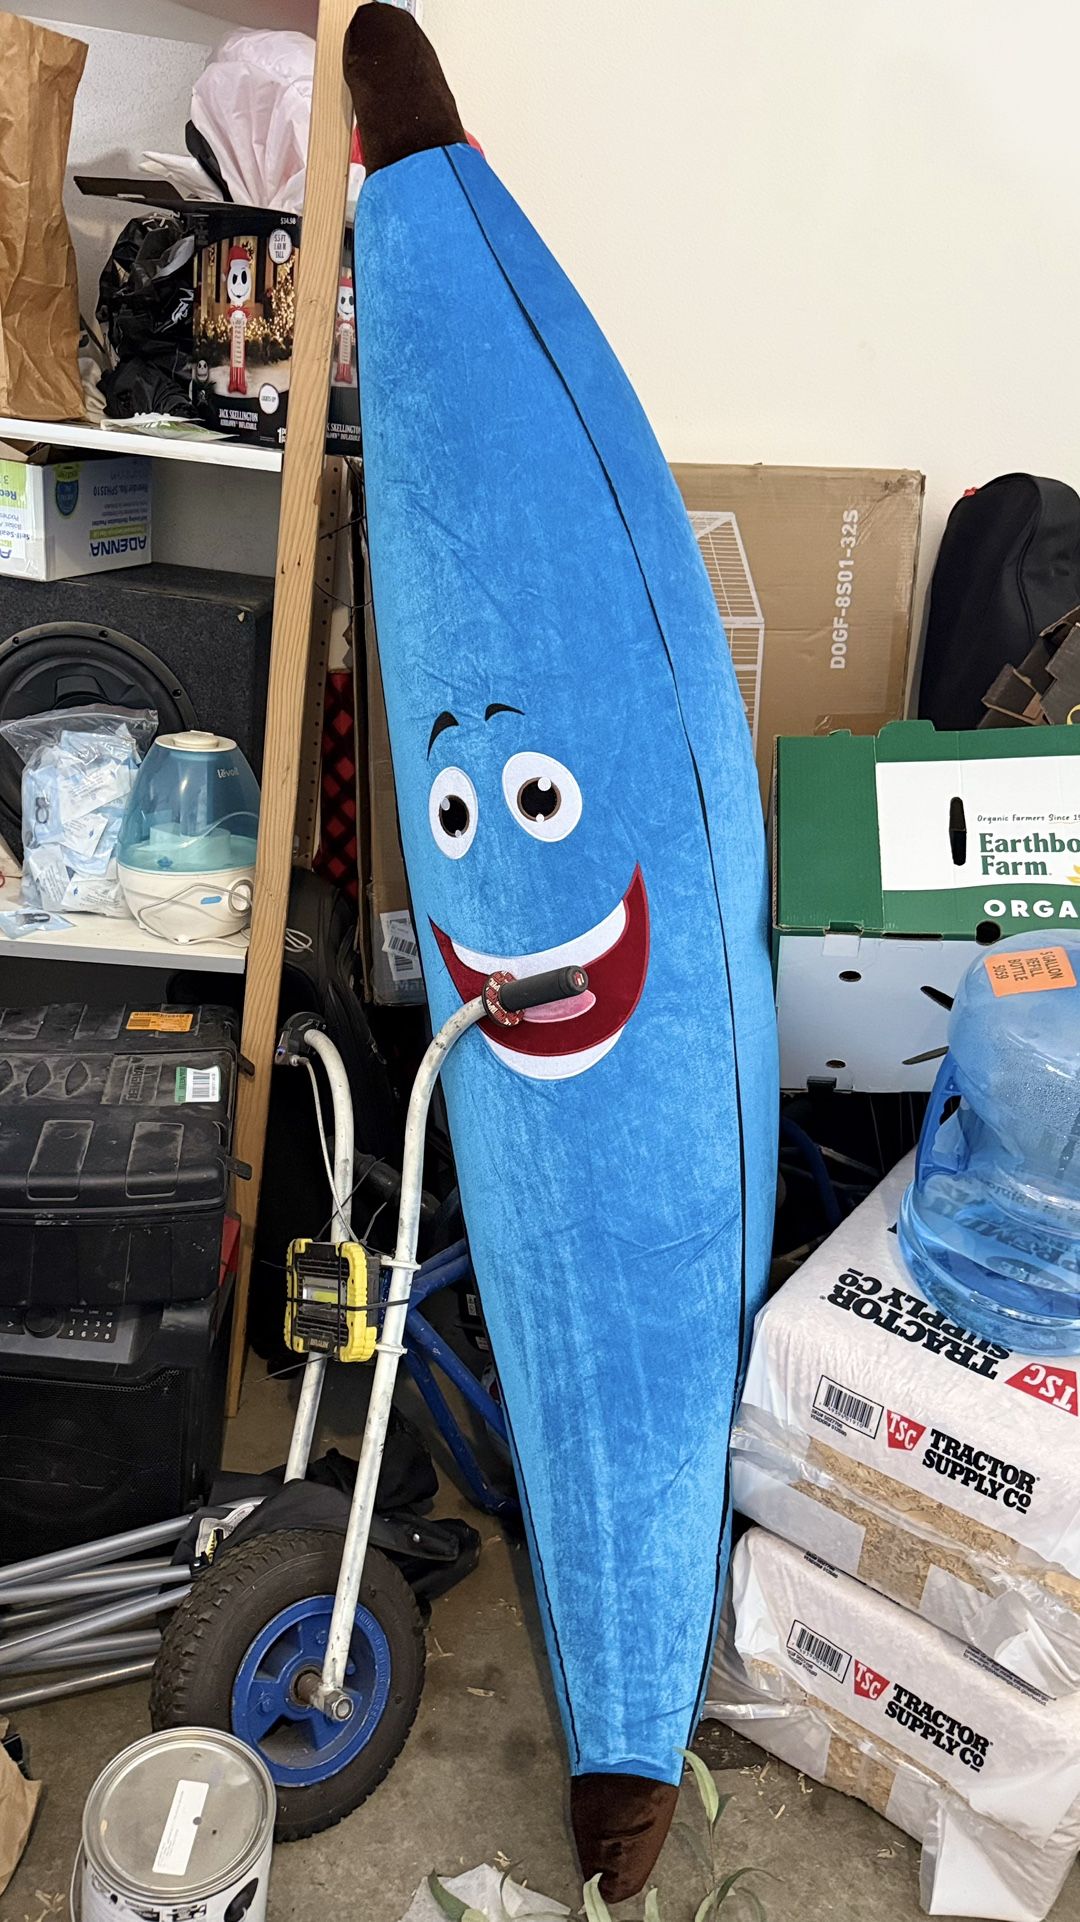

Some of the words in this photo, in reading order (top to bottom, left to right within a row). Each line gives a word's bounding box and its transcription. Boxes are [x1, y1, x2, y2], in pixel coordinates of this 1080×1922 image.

[219, 408, 229, 419] JACK
[229, 409, 259, 422] SKELLINGTON
[90, 535, 147, 557] ADENNA
[830, 509, 859, 669] DOGF-8S01-32S
[977, 814, 1009, 824] Organic
[1048, 813, 1070, 822] Since
[981, 855, 1048, 876] Farm
[983, 899, 1079, 918] ORGA
[1008, 958, 1029, 982] BOTTLE
[1025, 957, 1045, 977] REFILL
[1042, 954, 1064, 980] GALLON
[68, 1329, 74, 1337] 5
[81, 1330, 86, 1338] 6
[827, 1284, 998, 1380] TRACTOR
[1023, 1364, 1076, 1412] TSC
[888, 1411, 918, 1450] TSC
[922, 1448, 1005, 1502] SUPPLY
[930, 1428, 1036, 1495] TRACTOR
[855, 1663, 881, 1699] TSC
[884, 1701, 960, 1757] SUPPLY
[893, 1683, 990, 1757] TRACTOR
